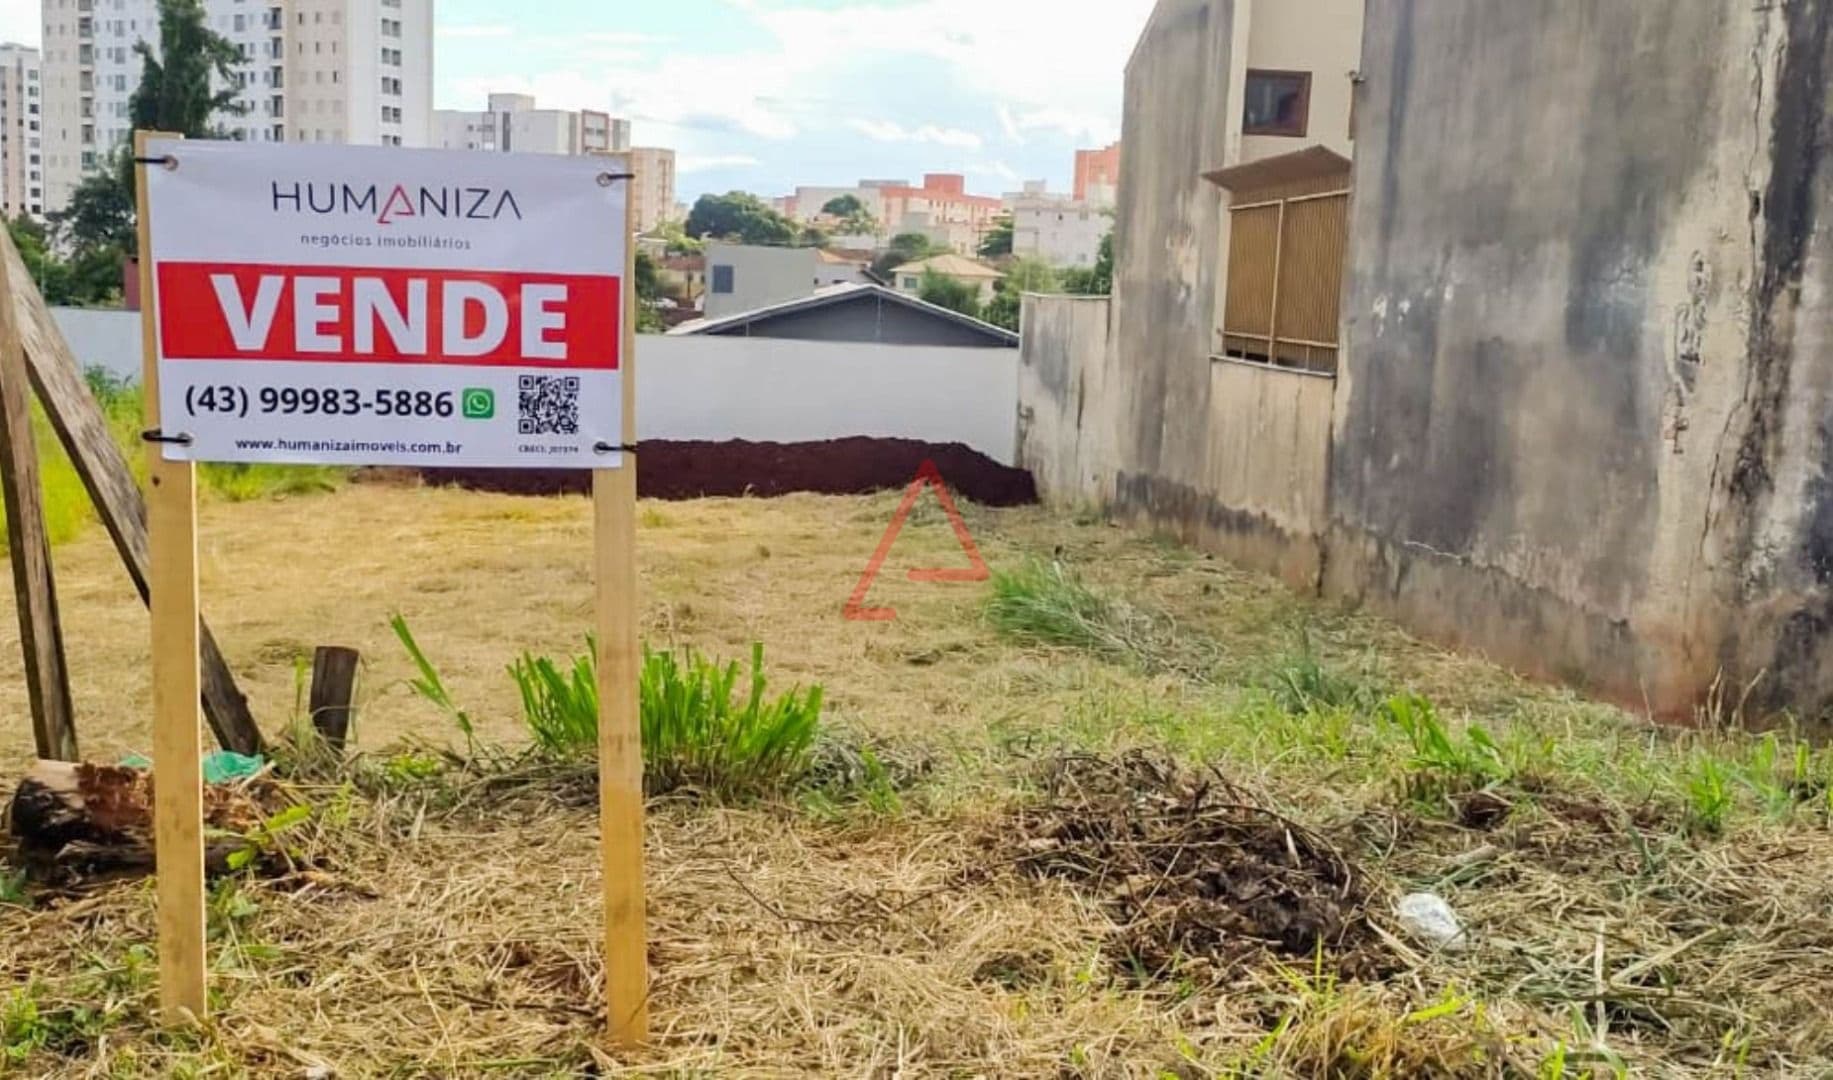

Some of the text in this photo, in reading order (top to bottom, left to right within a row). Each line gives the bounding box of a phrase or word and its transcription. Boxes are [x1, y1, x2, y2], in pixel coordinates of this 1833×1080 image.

[271, 180, 523, 223] HUMANIZA
[300, 232, 471, 250] negócios imobiliários
[210, 273, 568, 360] VENDE
[185, 385, 455, 418] (43) 99983-5886
[235, 438, 463, 455] www.humanizaimoveis.com.br
